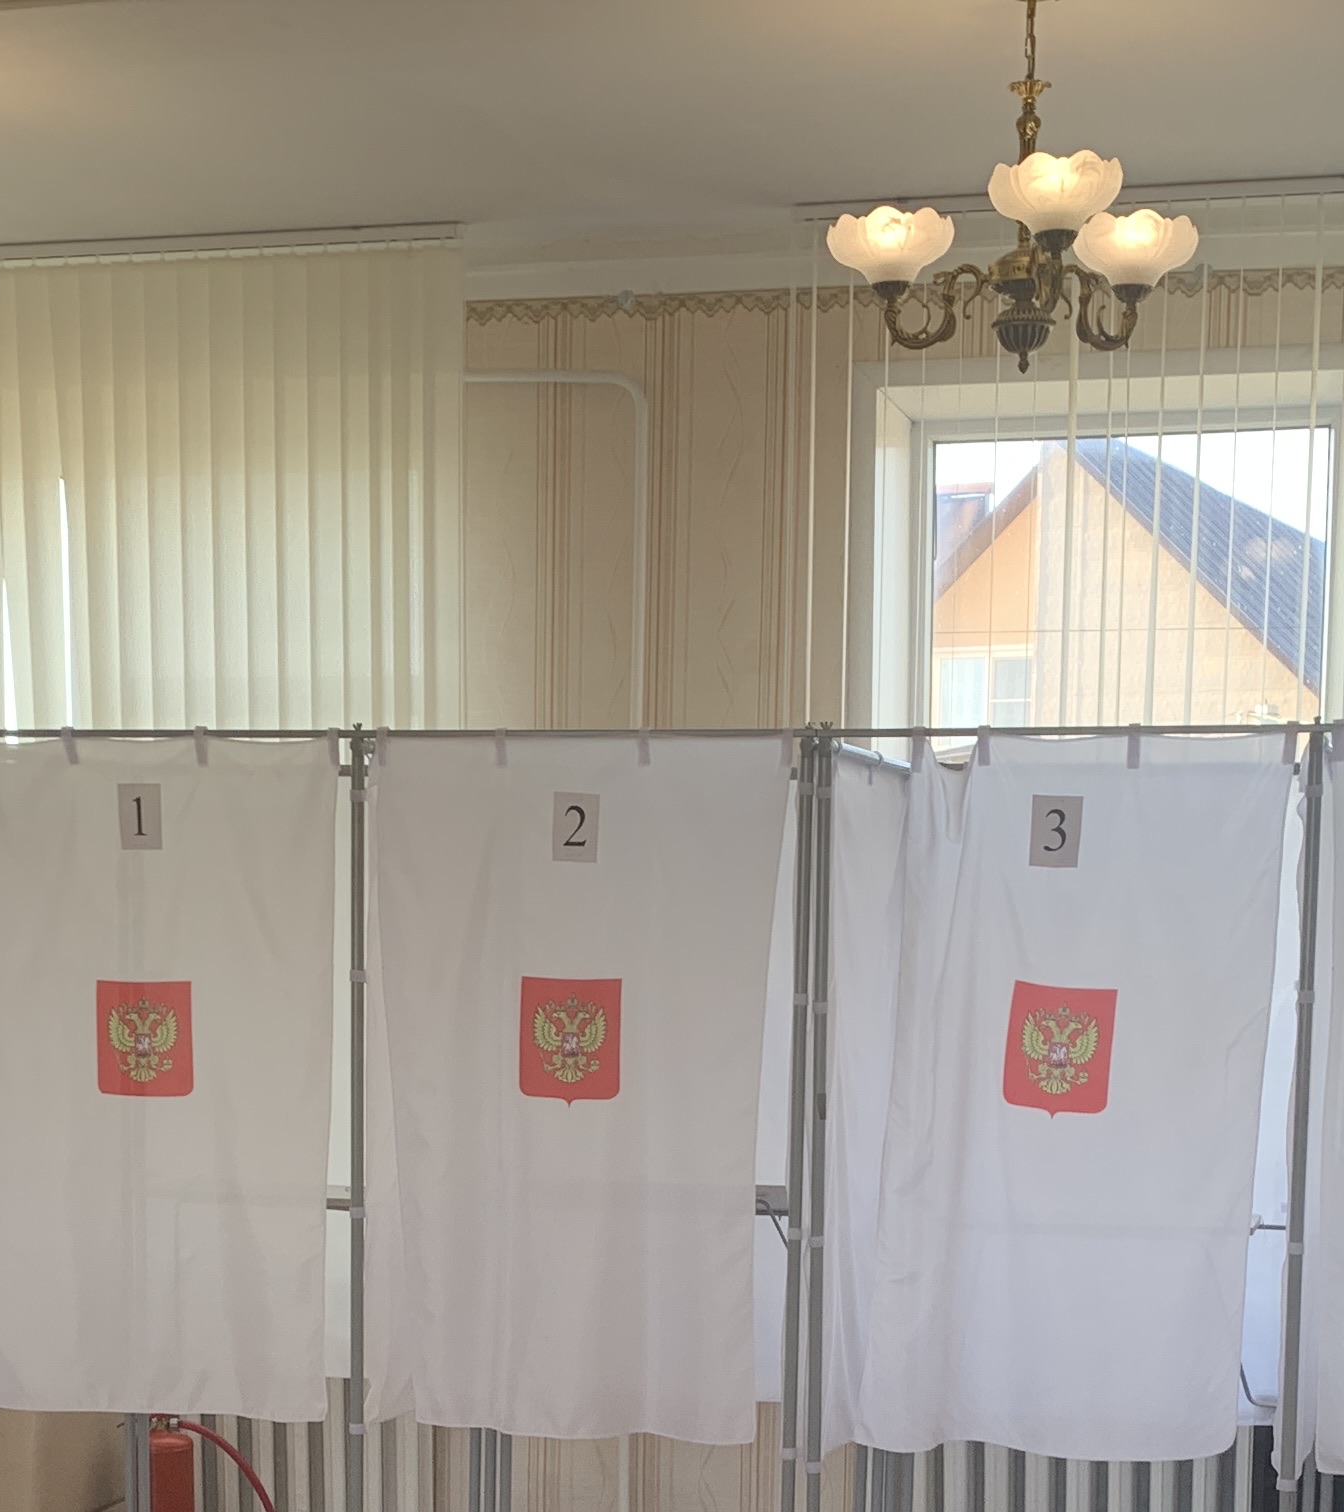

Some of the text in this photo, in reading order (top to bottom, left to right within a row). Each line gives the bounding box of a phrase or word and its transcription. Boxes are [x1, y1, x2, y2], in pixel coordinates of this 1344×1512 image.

[132, 796, 147, 836] 1
[563, 805, 587, 847] 2
[1043, 808, 1066, 852] 3
